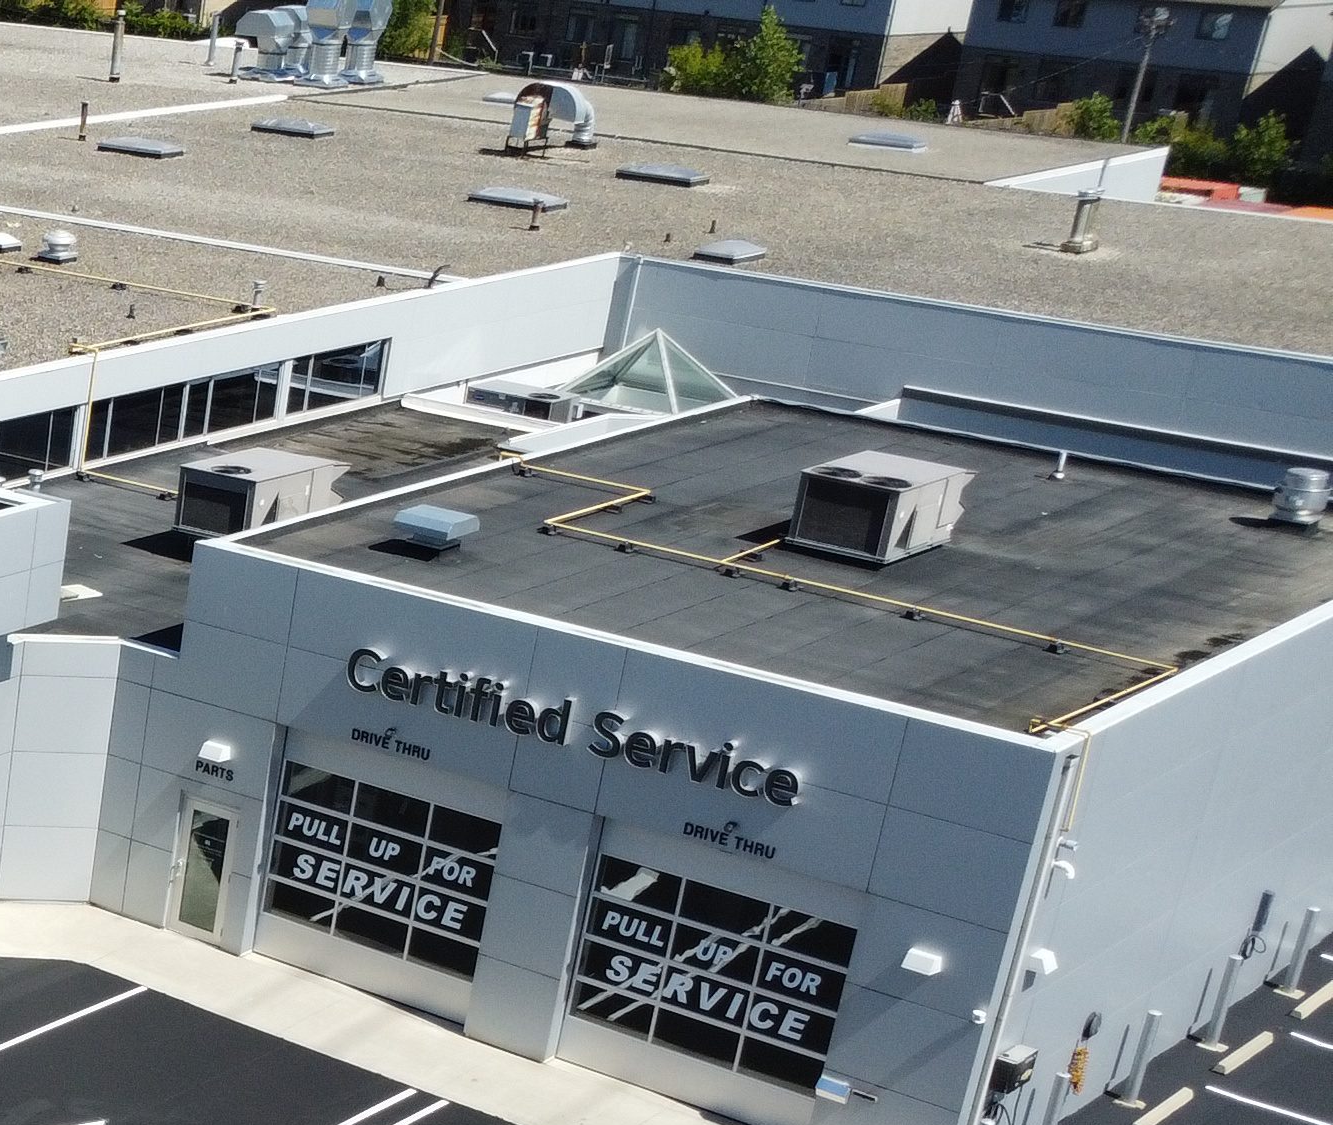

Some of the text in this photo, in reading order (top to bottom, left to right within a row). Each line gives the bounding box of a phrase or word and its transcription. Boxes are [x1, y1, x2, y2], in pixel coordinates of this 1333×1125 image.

[346, 647, 802, 806] Certified Service
[351, 728, 430, 761] DRIVE THRU
[195, 760, 234, 782] PARTS
[287, 811, 477, 888] PULL UP FOR
[683, 822, 776, 859] DRIVE THRU
[292, 853, 469, 930] SERVICE
[601, 910, 822, 996] PULL UP FOR
[605, 954, 811, 1041] SERVICE
